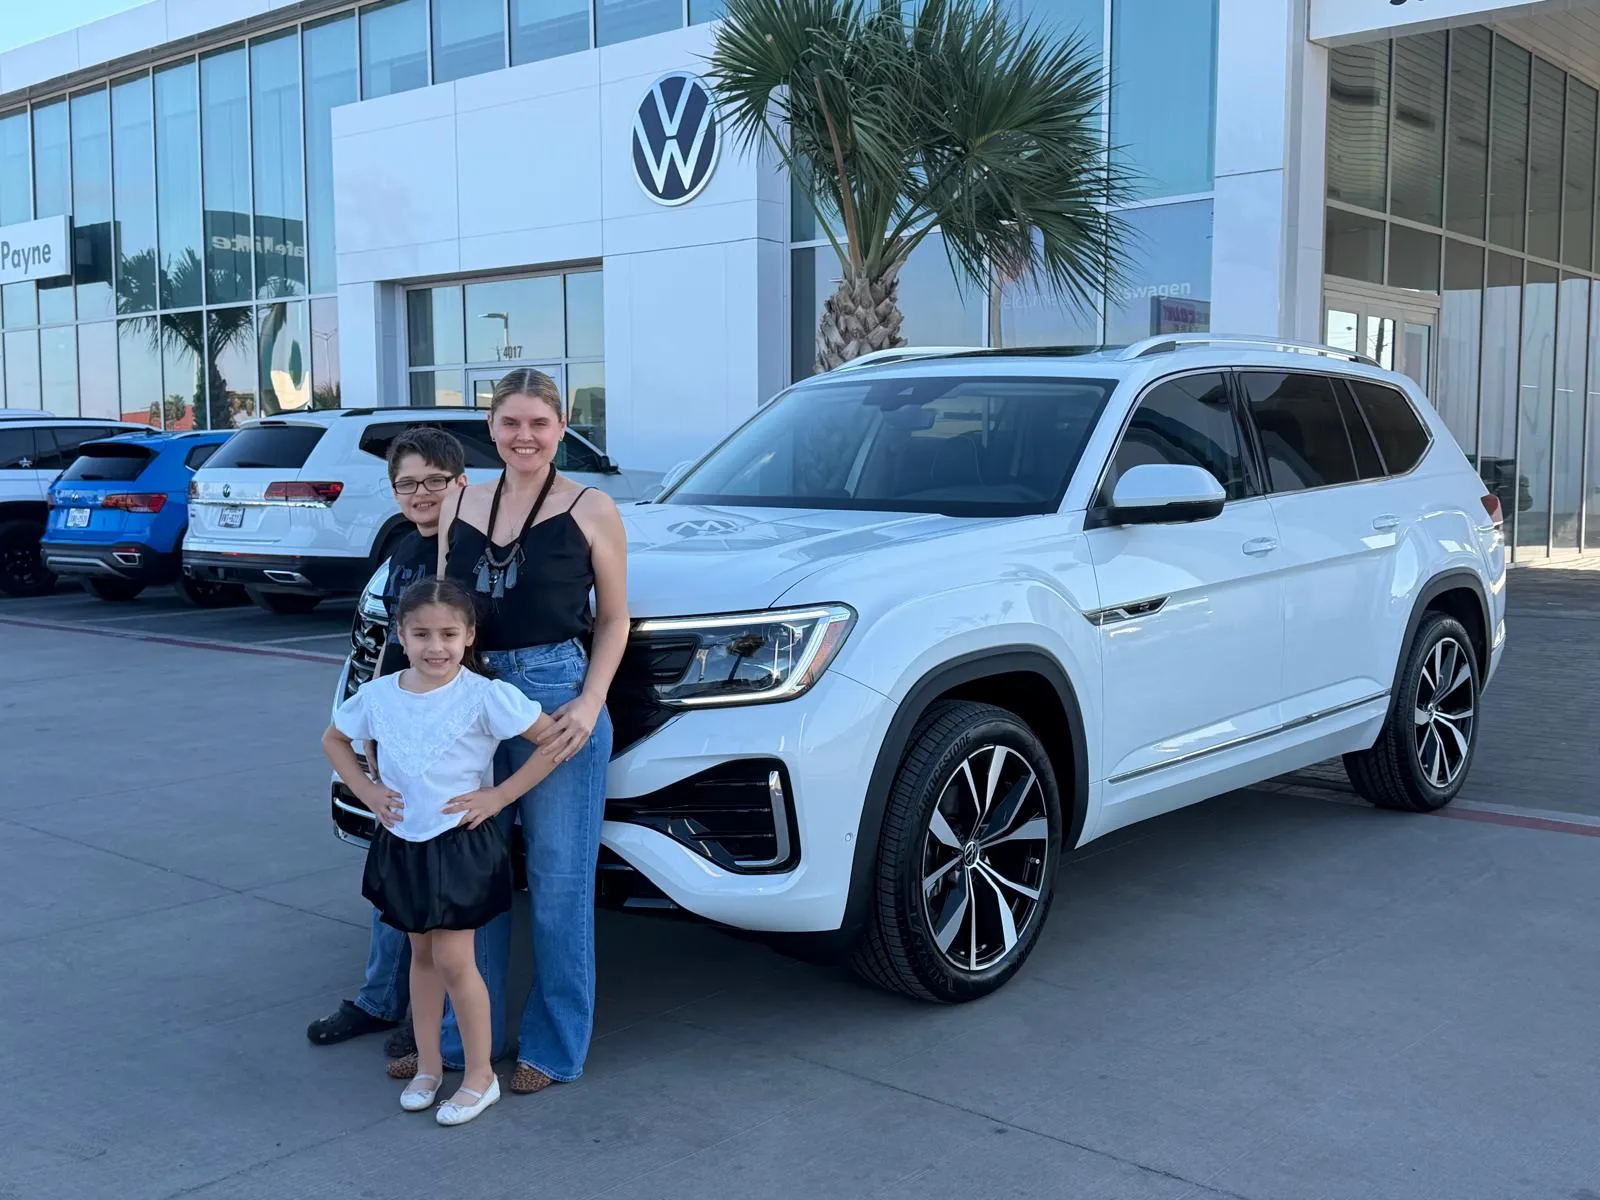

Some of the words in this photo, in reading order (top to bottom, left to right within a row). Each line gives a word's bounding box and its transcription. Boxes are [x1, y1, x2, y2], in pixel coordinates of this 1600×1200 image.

[1, 240, 52, 275] Payne
[1086, 281, 1191, 301] Vswagen
[503, 345, 523, 360] 4017
